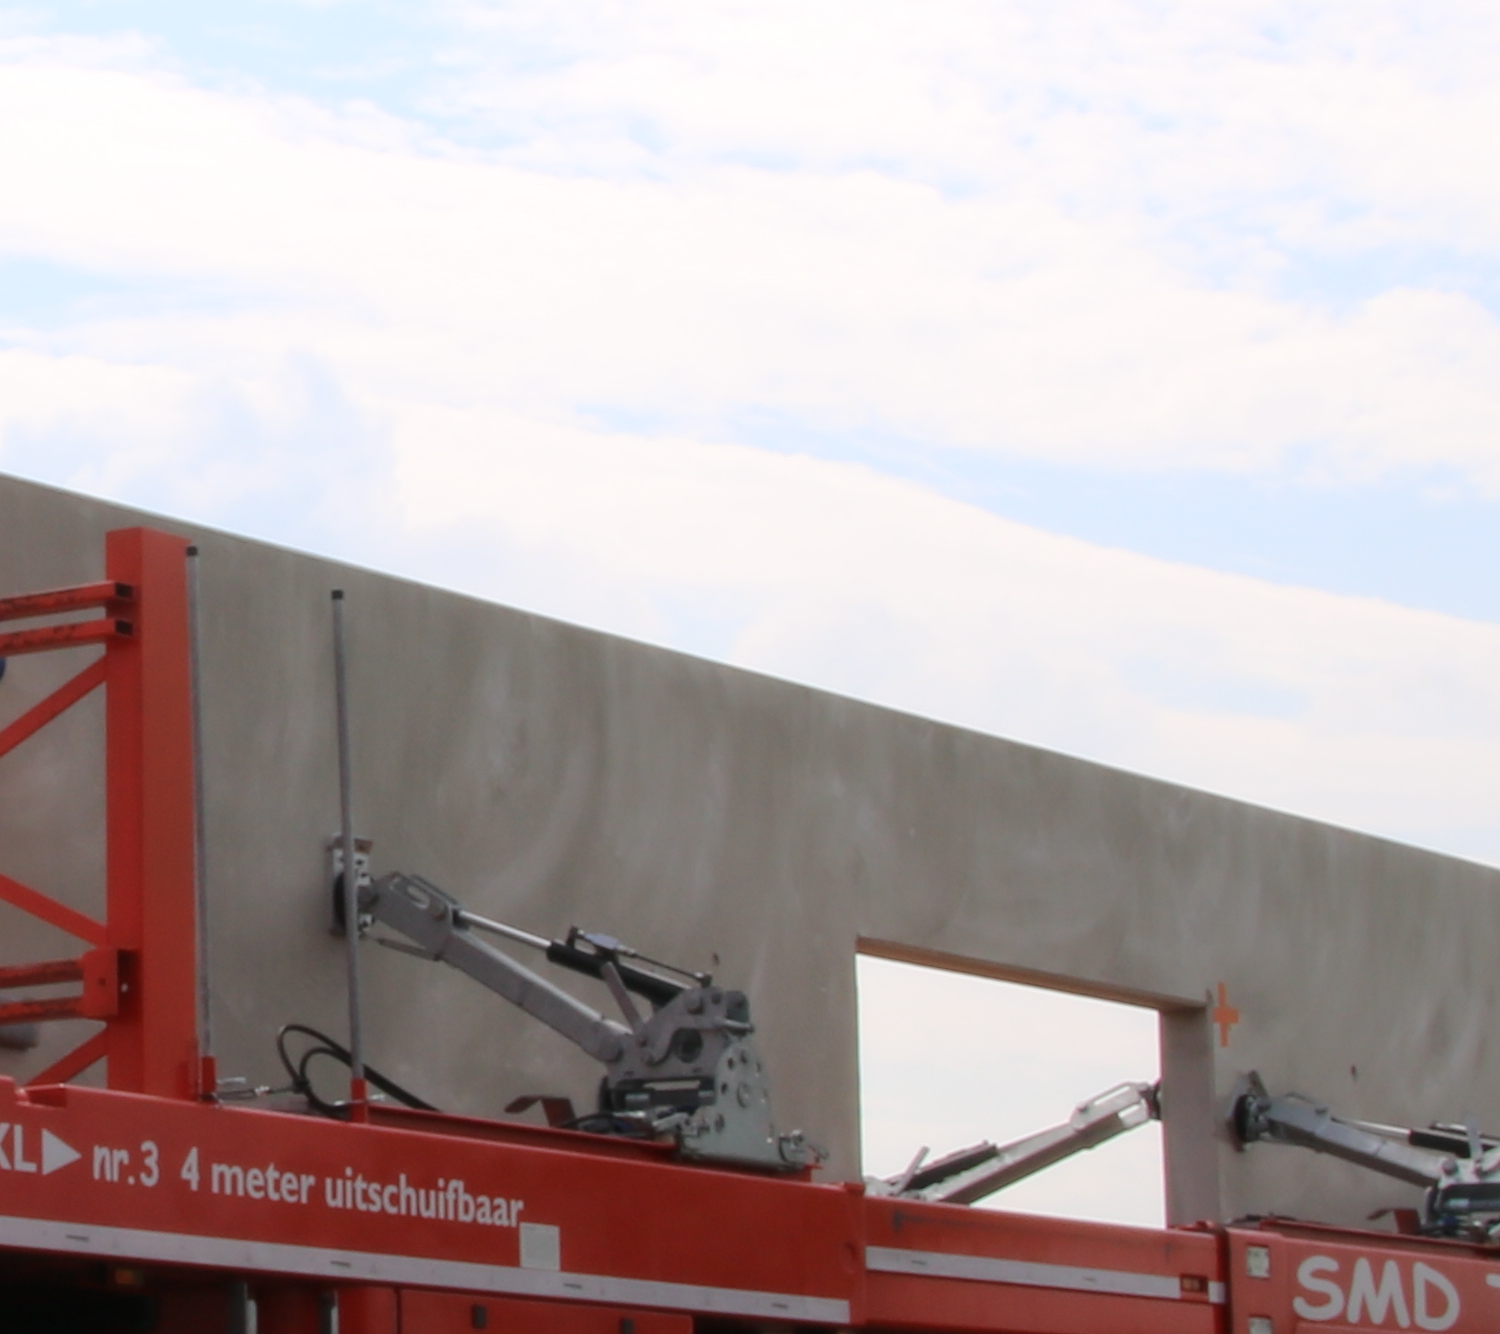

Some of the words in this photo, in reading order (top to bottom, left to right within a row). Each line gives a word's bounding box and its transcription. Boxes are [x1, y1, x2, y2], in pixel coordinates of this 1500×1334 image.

[180, 1146, 200, 1191] 4
[211, 1163, 316, 1204] meter
[324, 1166, 524, 1228] uitschuifbaar
[1292, 1254, 1461, 1331] SMD
